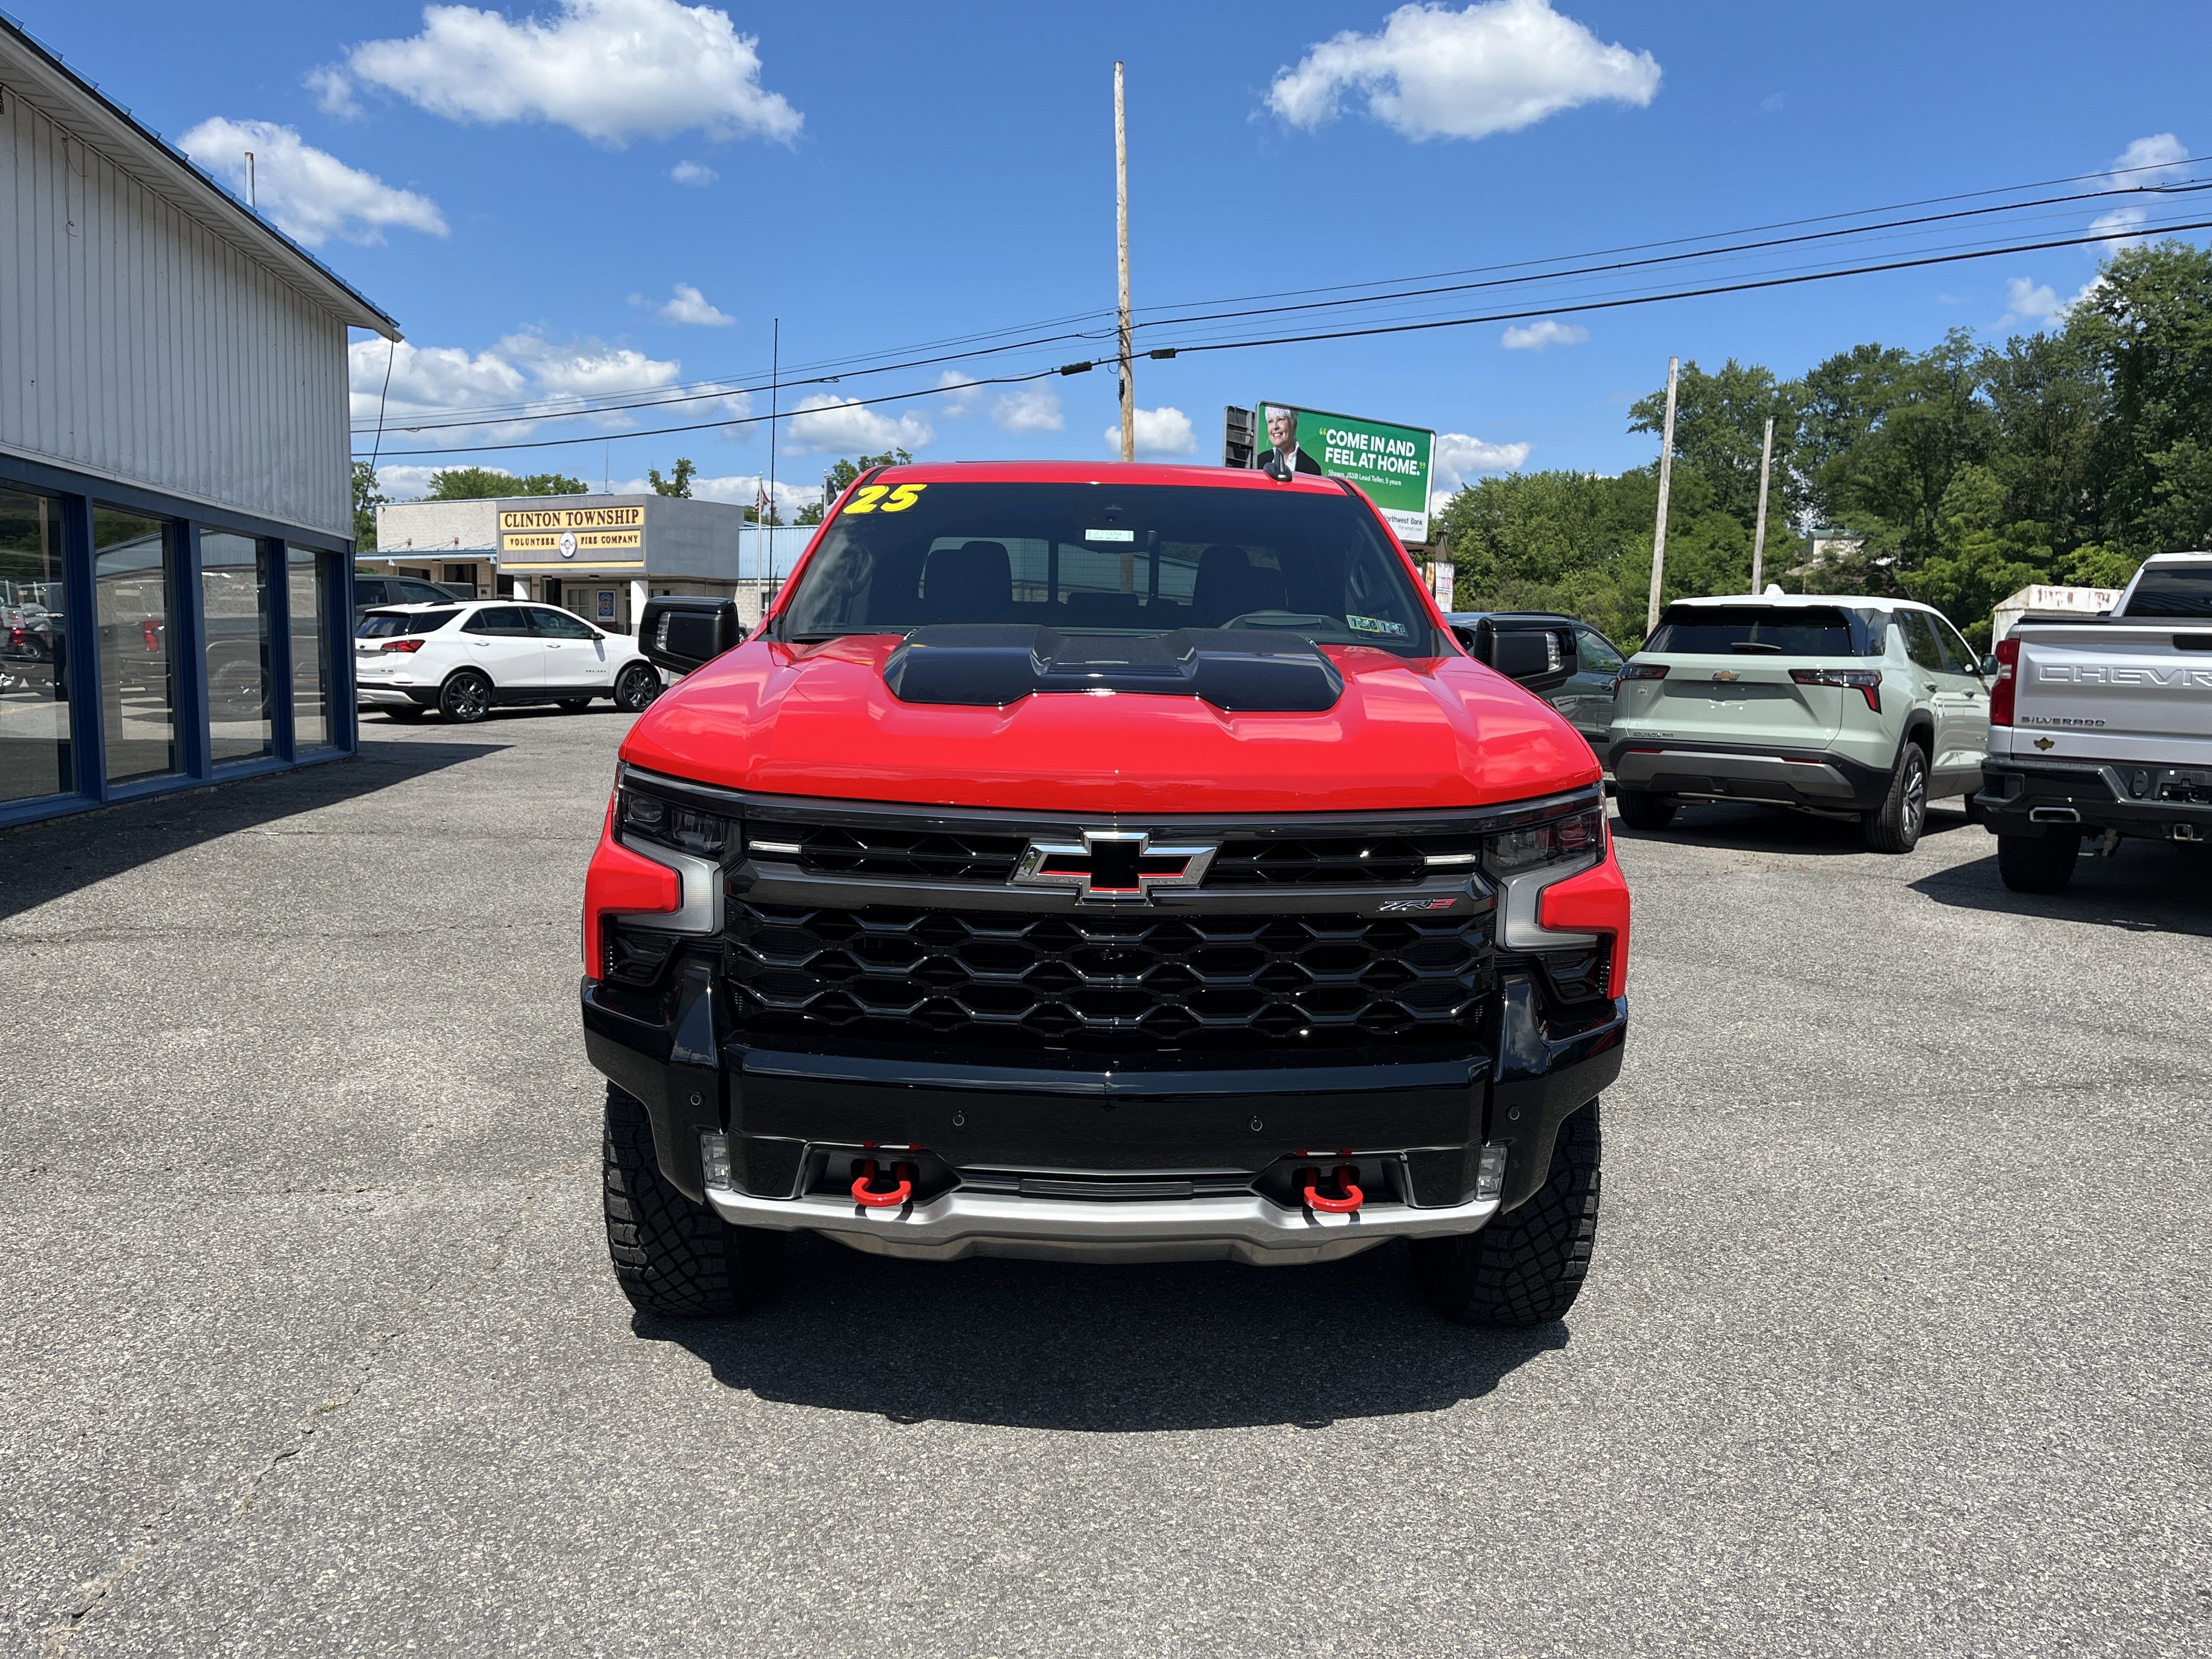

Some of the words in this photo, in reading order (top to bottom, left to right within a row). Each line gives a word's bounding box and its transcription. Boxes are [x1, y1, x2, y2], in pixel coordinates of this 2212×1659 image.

[1370, 436, 1385, 453] IN
[1386, 439, 1415, 457] AND
[1325, 447, 1357, 466] FEEL
[1358, 452, 1376, 469] AT
[1372, 475, 1385, 484] Teller,
[843, 484, 927, 514] 25
[504, 512, 561, 527] CLINTON
[566, 509, 639, 526] TOWNSHIP
[510, 538, 555, 546] VOLUNTEER
[580, 536, 597, 545] FIRE
[601, 535, 638, 544] COMPANY
[2021, 716, 2106, 727] SILVERADO
[1376, 898, 1457, 912] ZR2
